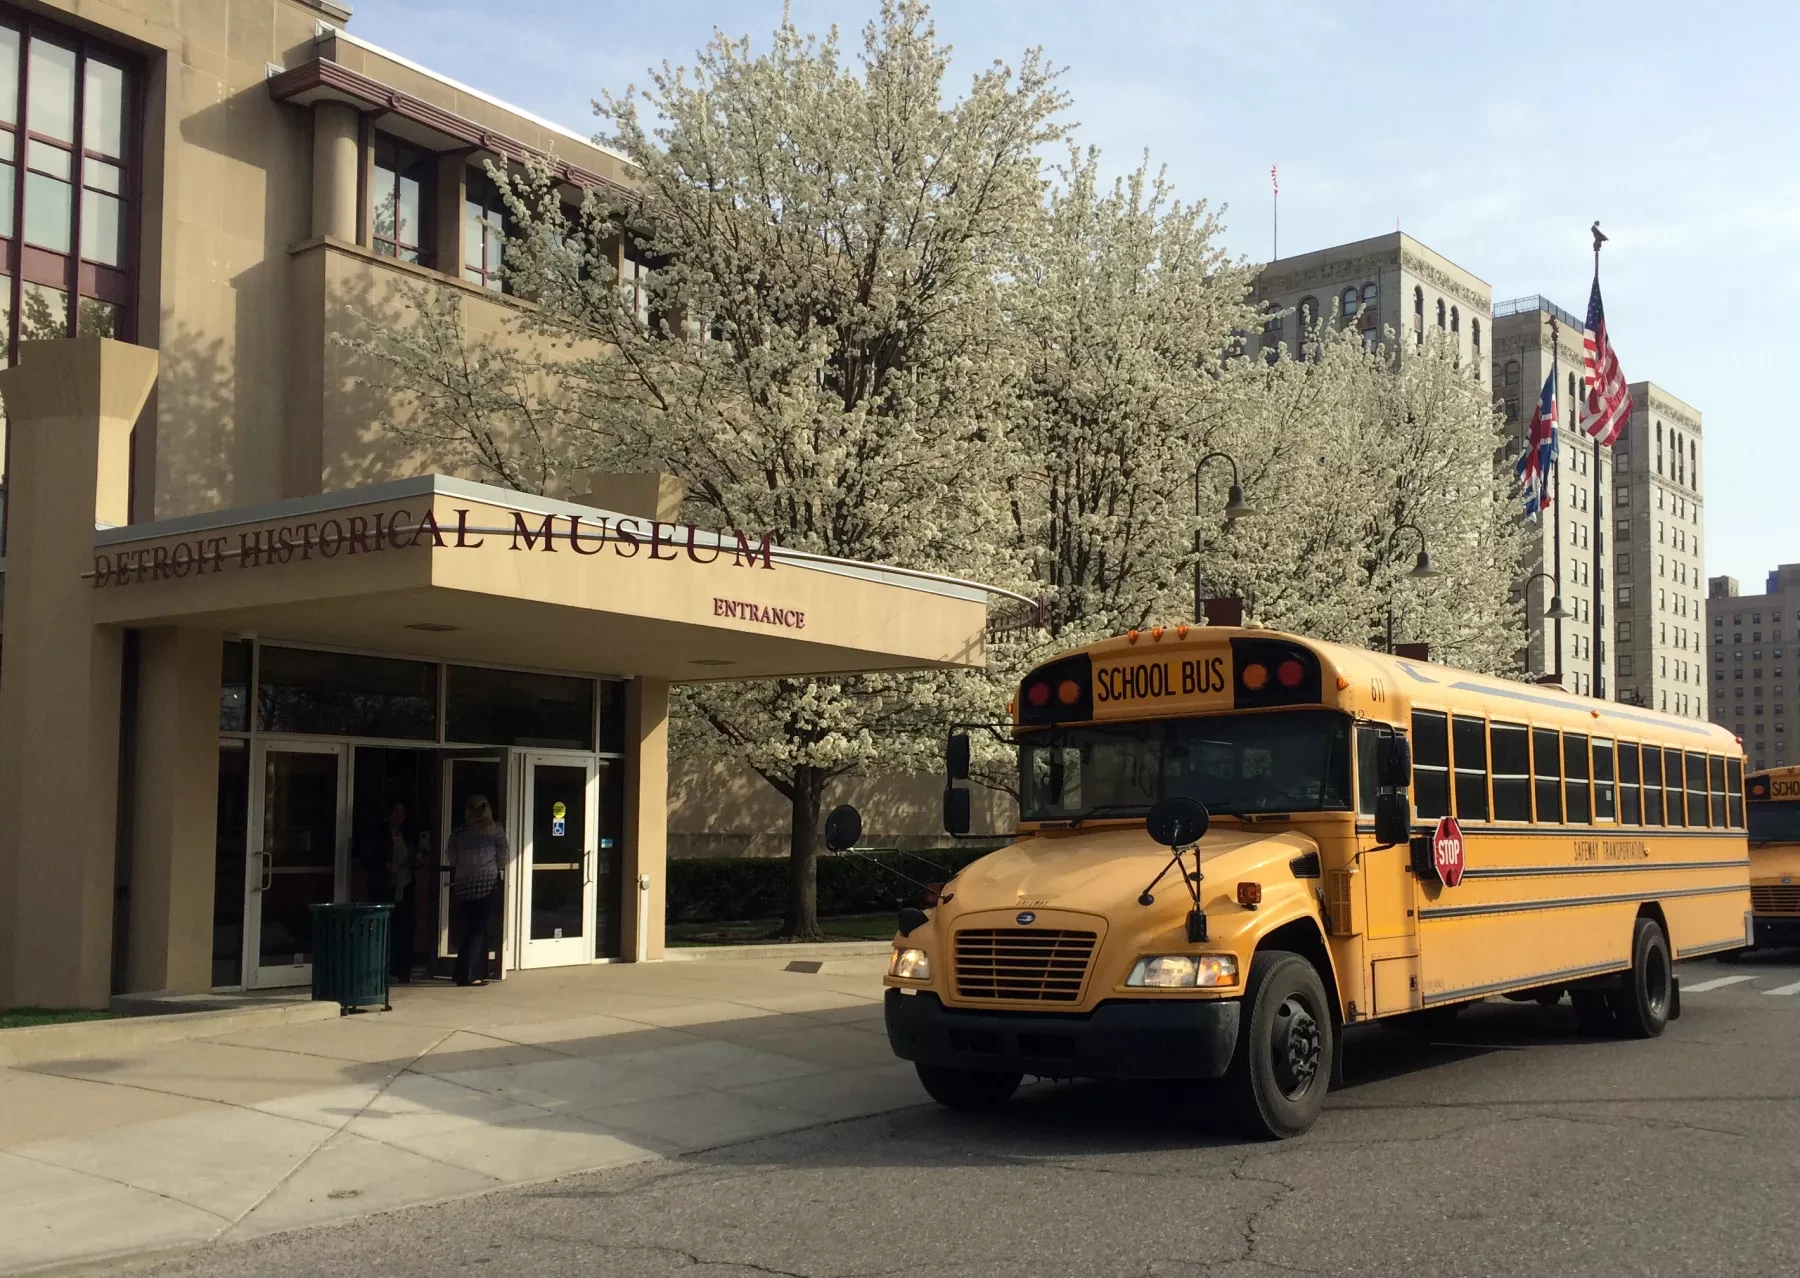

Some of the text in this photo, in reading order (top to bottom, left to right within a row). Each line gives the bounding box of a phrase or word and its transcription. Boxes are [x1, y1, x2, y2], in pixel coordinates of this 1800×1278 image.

[92, 508, 777, 589] DETROIT HISTORICAL MUSEUM
[712, 597, 806, 630] ENTRANCE
[1097, 656, 1226, 703] SCHOOL BUS
[1370, 677, 1386, 703] 611
[1438, 839, 1460, 865] STOP
[1573, 840, 1646, 861] SAFEWAY TRANSPORTATION
